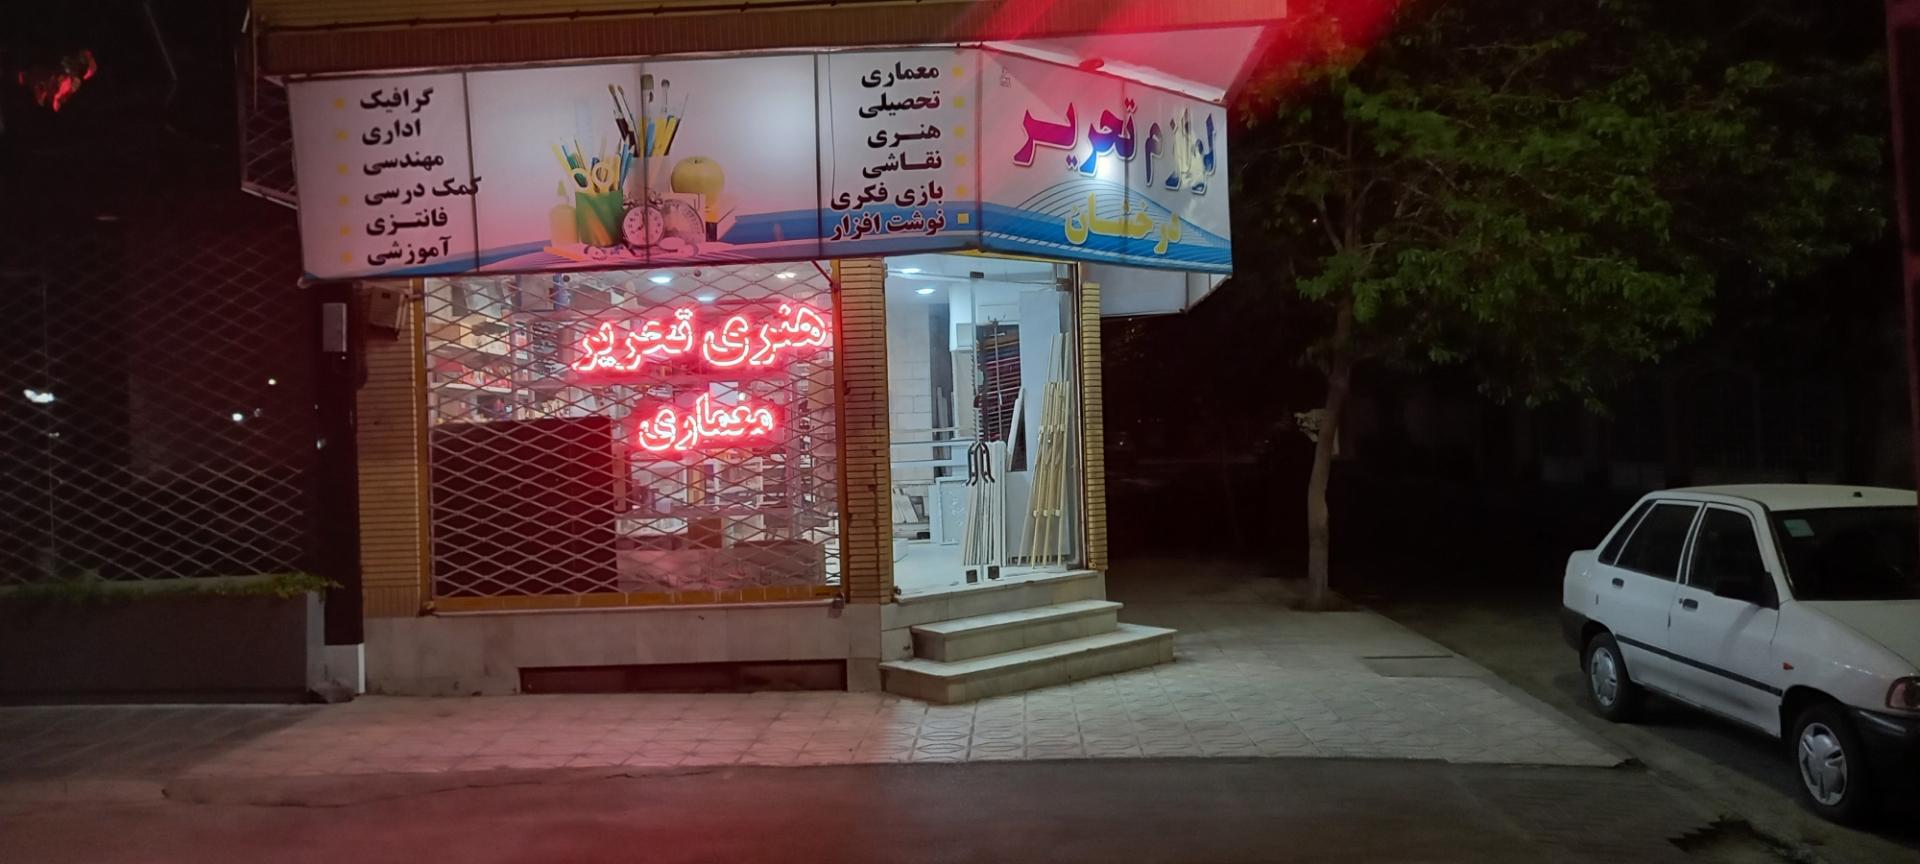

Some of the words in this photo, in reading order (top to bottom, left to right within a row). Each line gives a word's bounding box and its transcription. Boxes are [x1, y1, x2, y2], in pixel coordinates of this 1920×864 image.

[861, 61, 939, 87] معماری
[360, 86, 434, 113] گرافیک
[859, 90, 940, 118] تحصیلی
[362, 118, 421, 145] اداری
[867, 123, 941, 148] هنری
[1013, 96, 1136, 176] تحریر
[363, 151, 444, 176] مهندسی
[862, 151, 942, 178] نقاشی
[365, 182, 425, 206] درسی
[432, 176, 482, 197] کمک
[831, 182, 888, 210] فکری
[895, 180, 943, 207] بازی
[366, 206, 448, 236] فانتزی
[830, 213, 880, 241] افزار
[886, 210, 945, 235] نوشت
[1065, 192, 1182, 254] درخشان
[367, 236, 451, 266] آموزشی
[572, 307, 693, 371] تحریر
[703, 303, 827, 366] هنری
[638, 392, 773, 451] معماری
